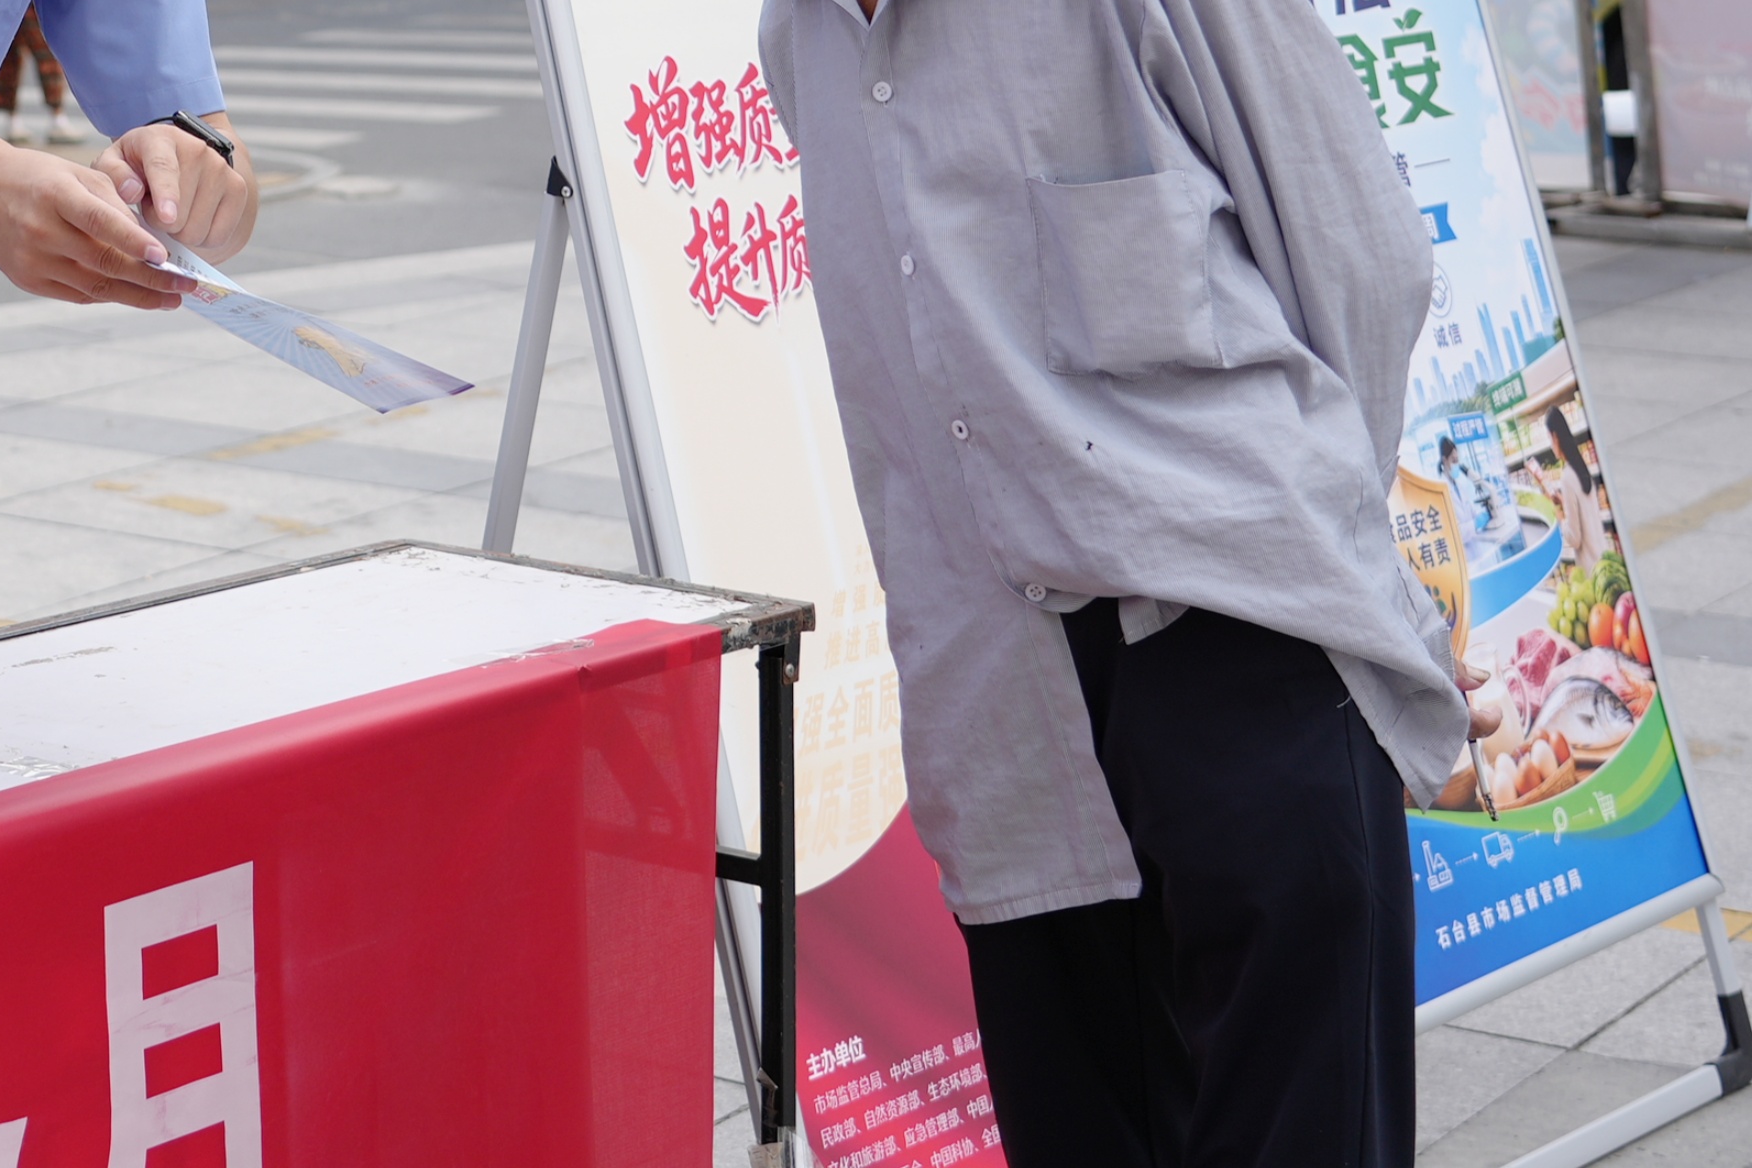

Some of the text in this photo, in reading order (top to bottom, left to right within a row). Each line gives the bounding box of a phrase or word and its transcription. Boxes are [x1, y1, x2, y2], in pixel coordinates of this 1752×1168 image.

[624, 55, 799, 189] 增强质
[795, 670, 900, 762] 强全面质
[1435, 867, 1583, 950] 石台县市场监督管理局
[806, 1035, 866, 1081] 主办单位
